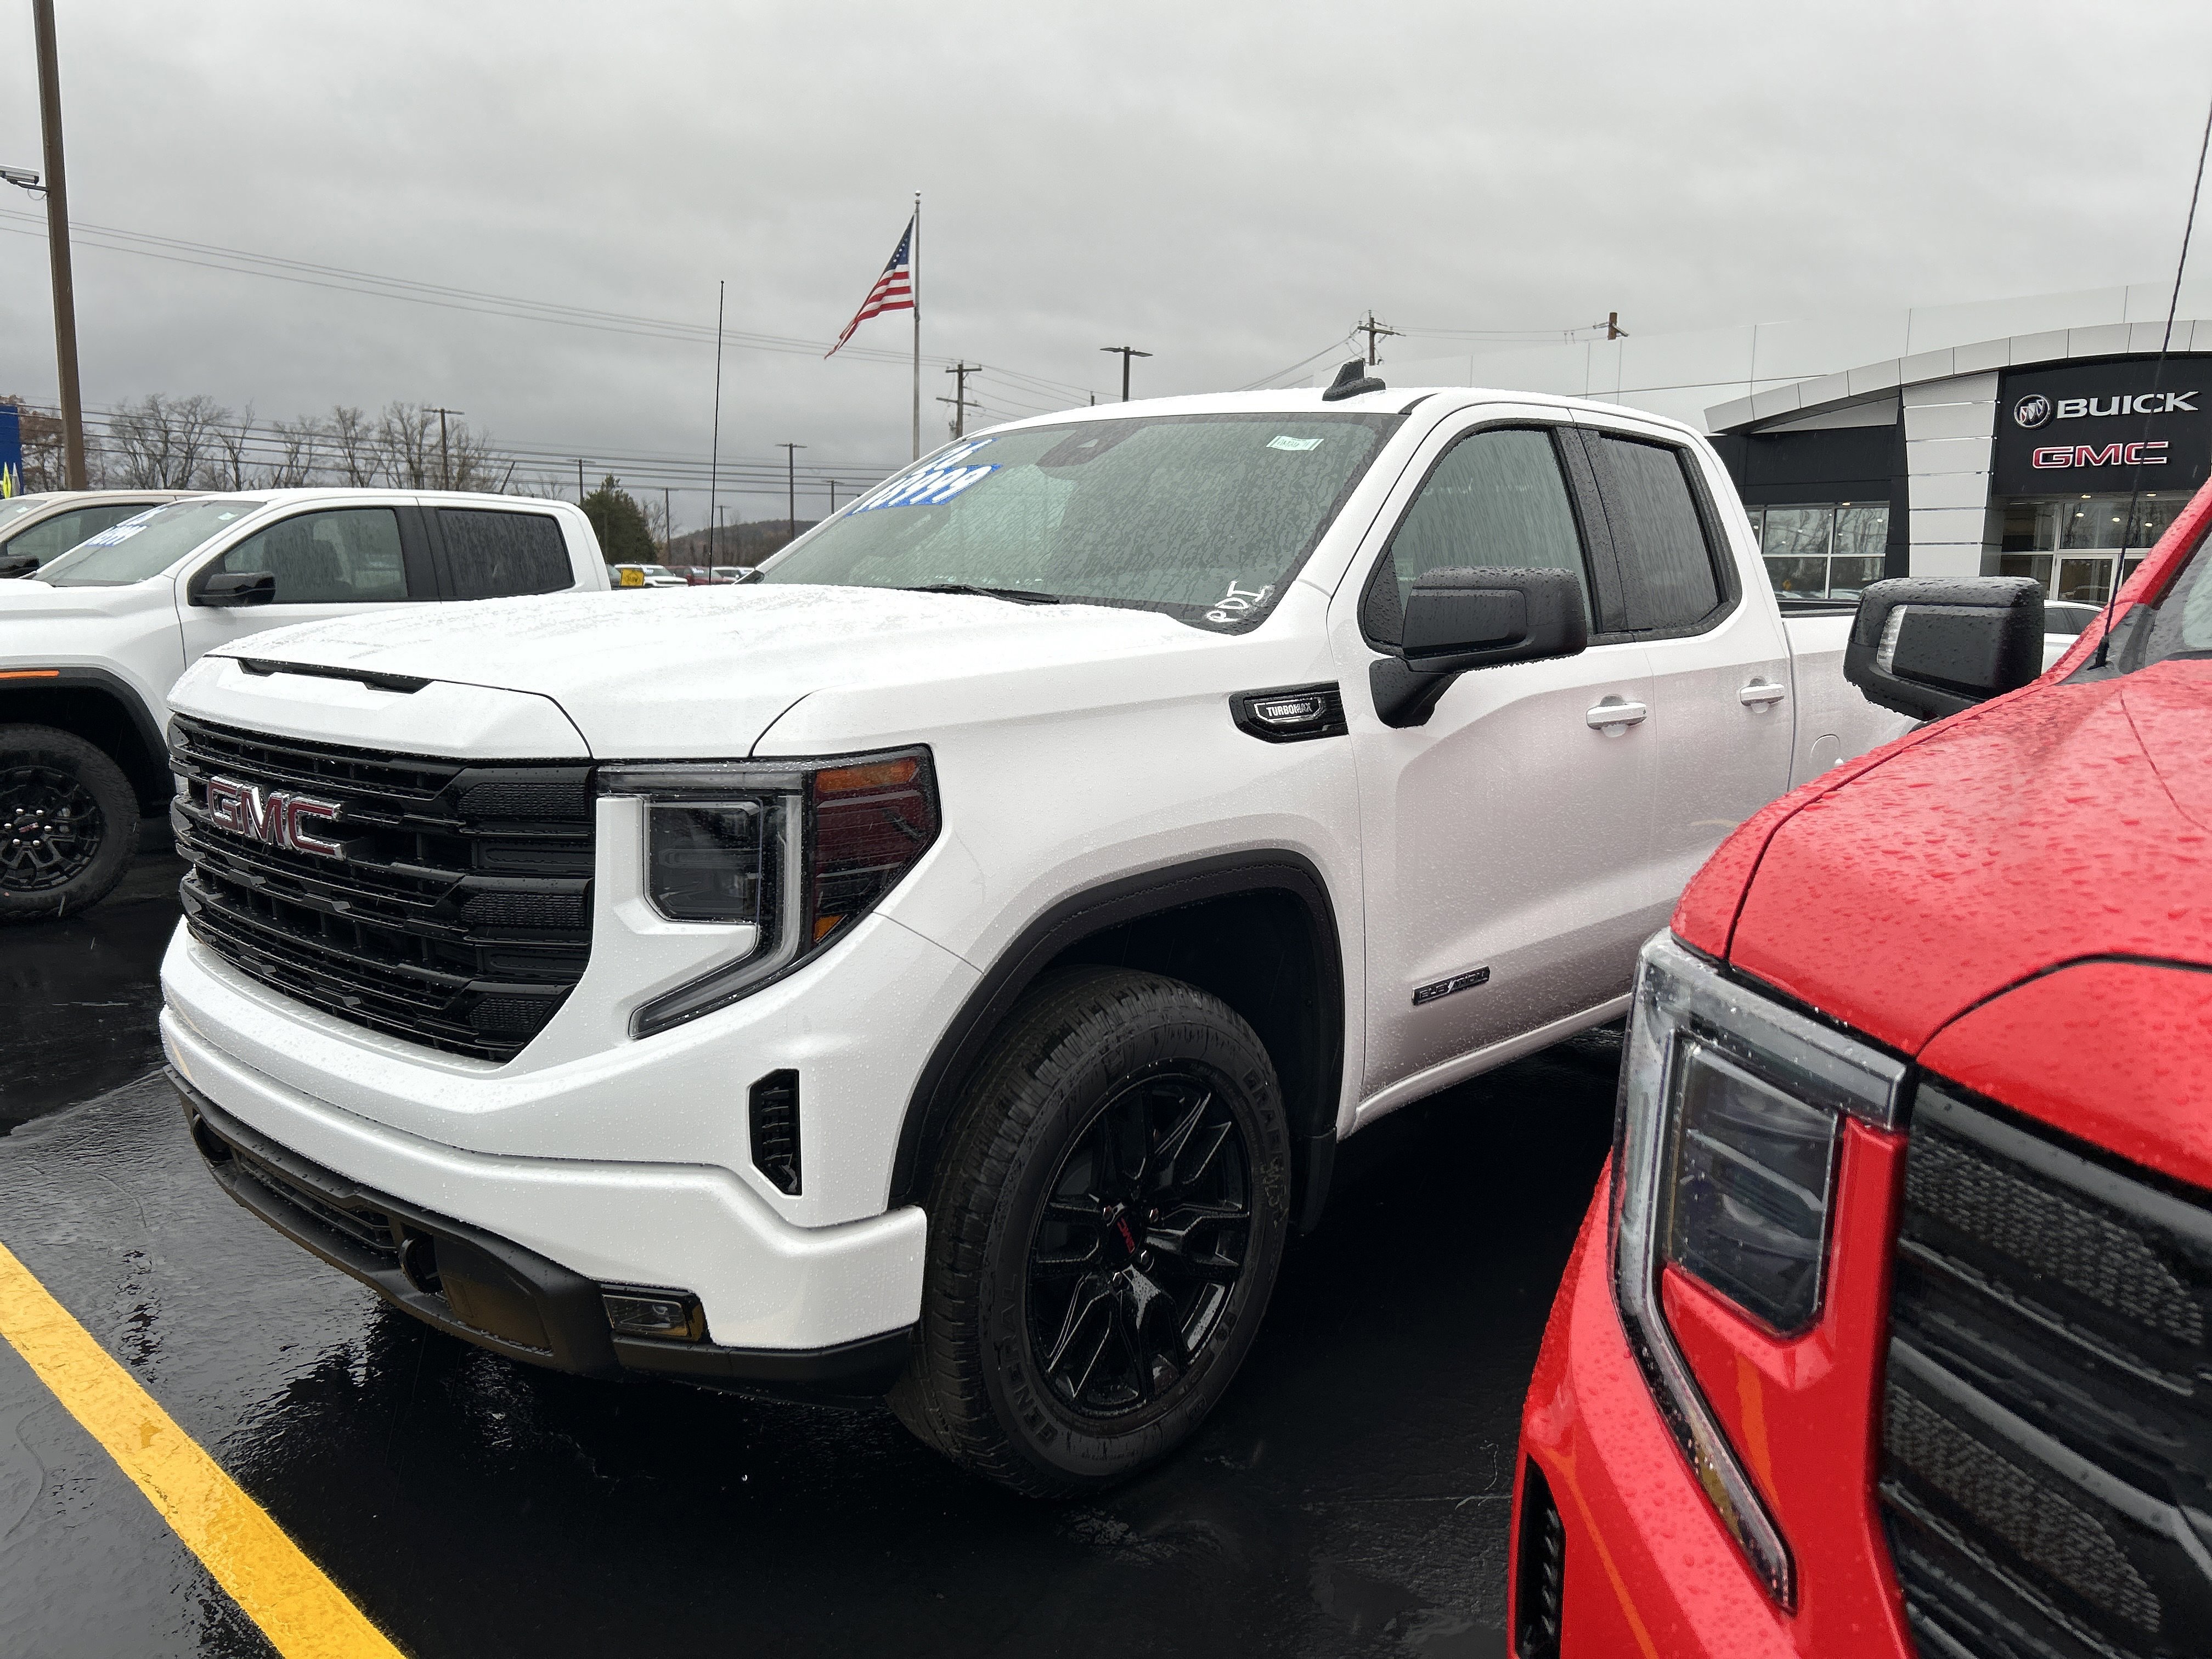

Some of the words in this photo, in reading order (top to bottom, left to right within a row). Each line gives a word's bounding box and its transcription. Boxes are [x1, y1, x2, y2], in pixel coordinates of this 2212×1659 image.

[2057, 391, 2199, 419] BUICK
[2032, 441, 2169, 469] GMC
[1206, 580, 1266, 623] PDI
[1266, 702, 1313, 716] TURBOMAX
[207, 776, 346, 861] GMC
